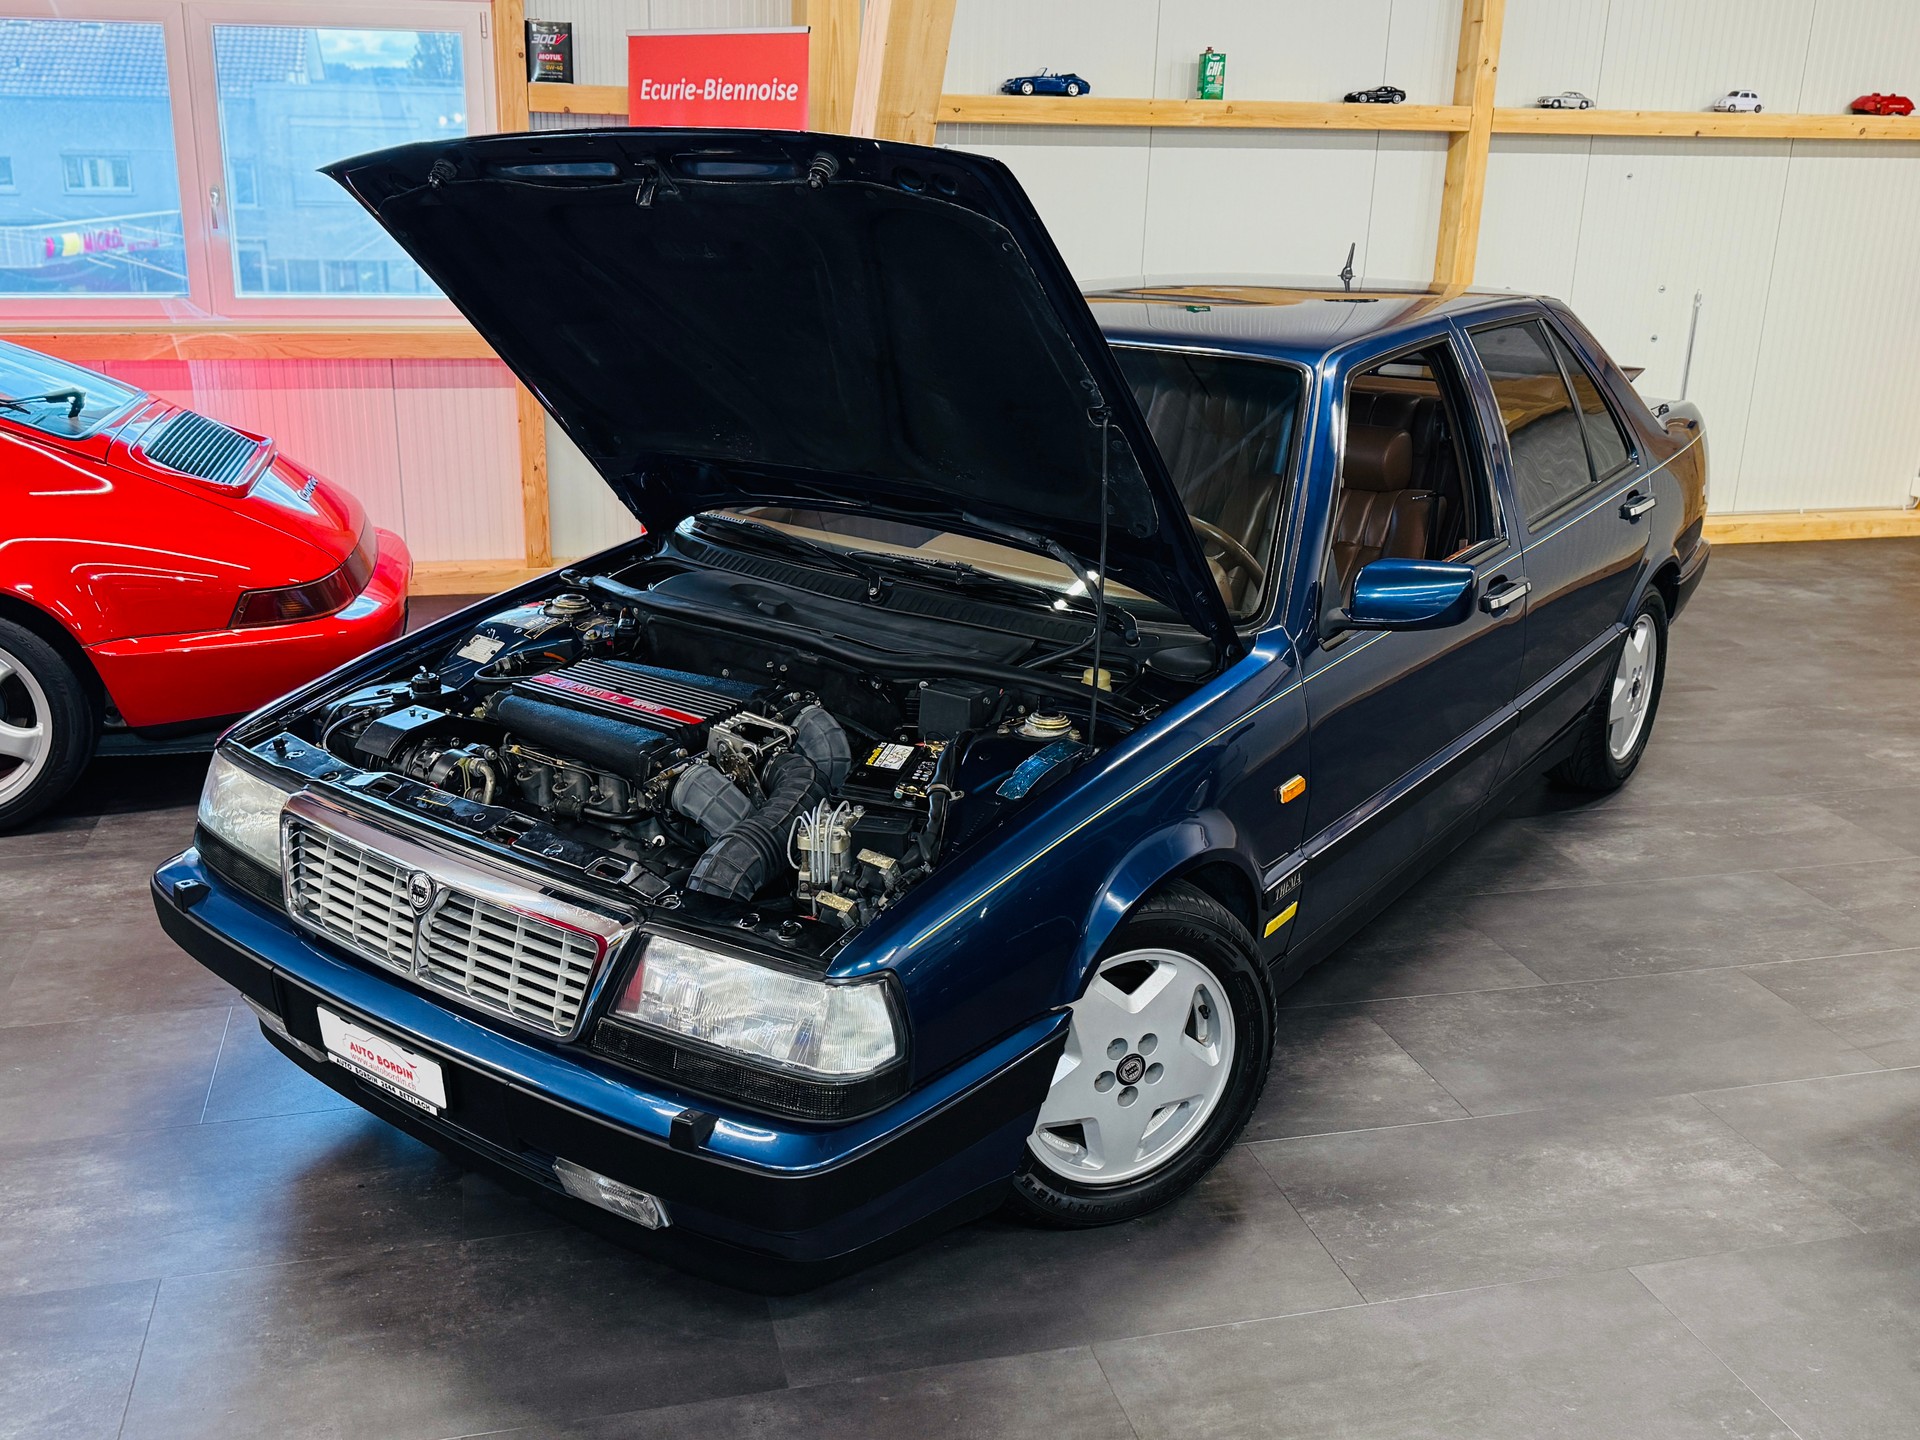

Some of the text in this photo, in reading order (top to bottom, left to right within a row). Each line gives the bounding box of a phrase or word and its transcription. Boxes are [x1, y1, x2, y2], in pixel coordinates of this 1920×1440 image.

[531, 33, 568, 45] 300V
[538, 53, 563, 61] MOTUL
[640, 77, 799, 101] Ecurie-Biennoise
[350, 1041, 414, 1081] AUTO BORDIN
[350, 1053, 417, 1091] www.autobordin.ch
[336, 1058, 352, 1070] AUTO
[355, 1068, 378, 1084] BORDIN
[399, 1090, 431, 1112] BETTLACH
